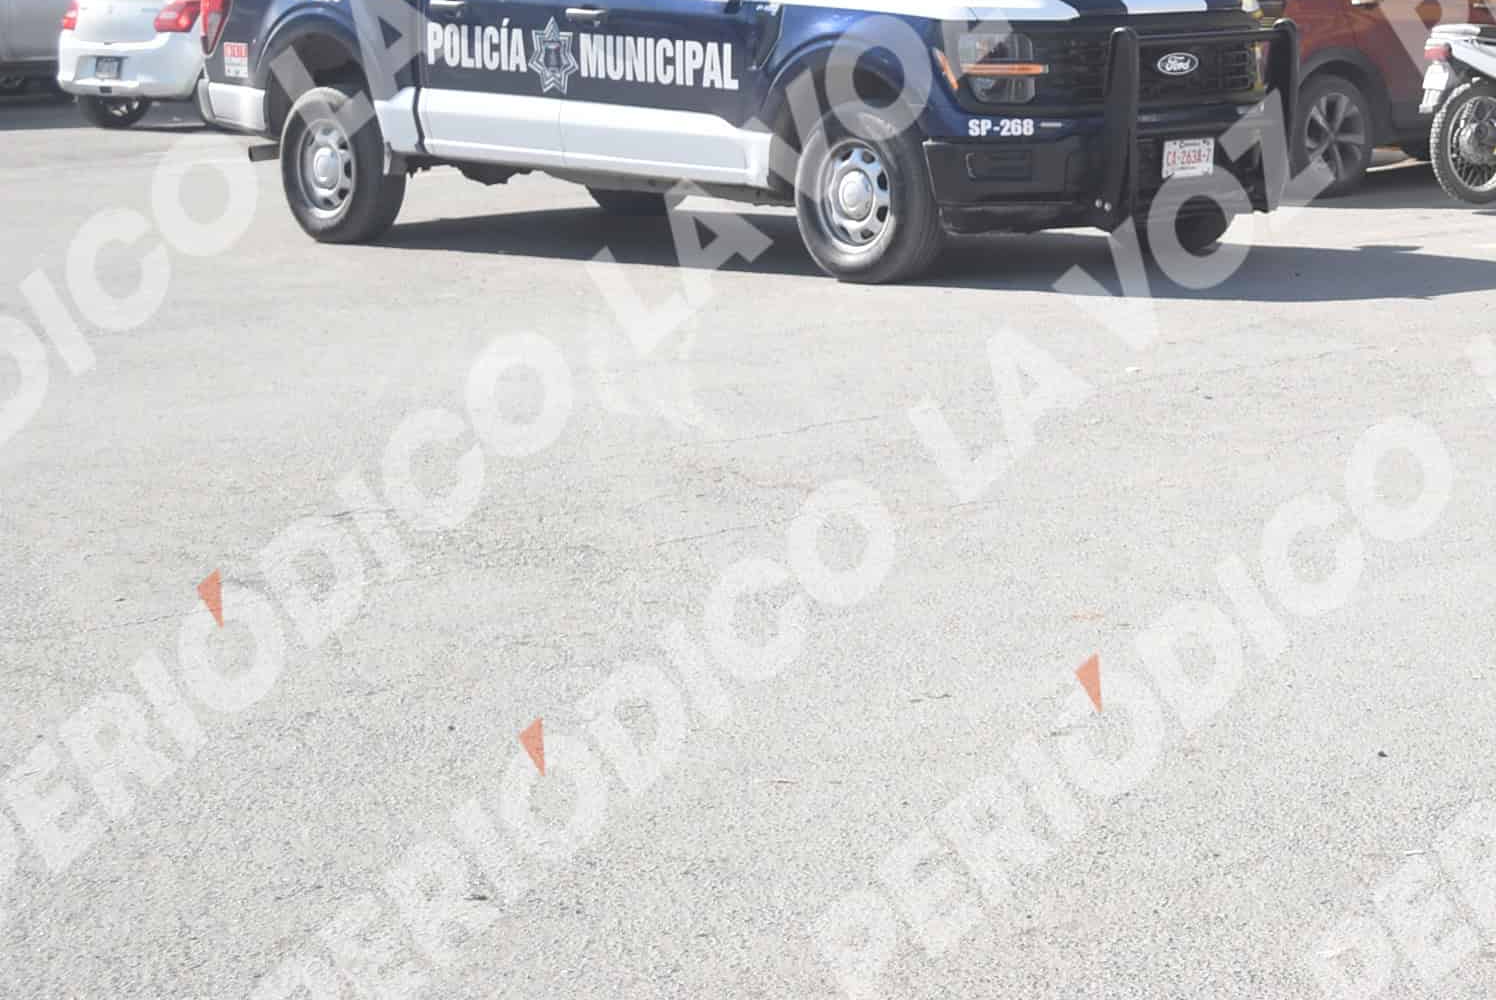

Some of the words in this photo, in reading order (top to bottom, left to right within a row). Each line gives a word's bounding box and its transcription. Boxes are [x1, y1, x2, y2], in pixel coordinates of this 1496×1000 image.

[427, 17, 528, 73] POLICÍA
[579, 33, 740, 90] MUNICIPAL
[1165, 55, 1192, 72] Ford
[967, 118, 1034, 137] SP-268
